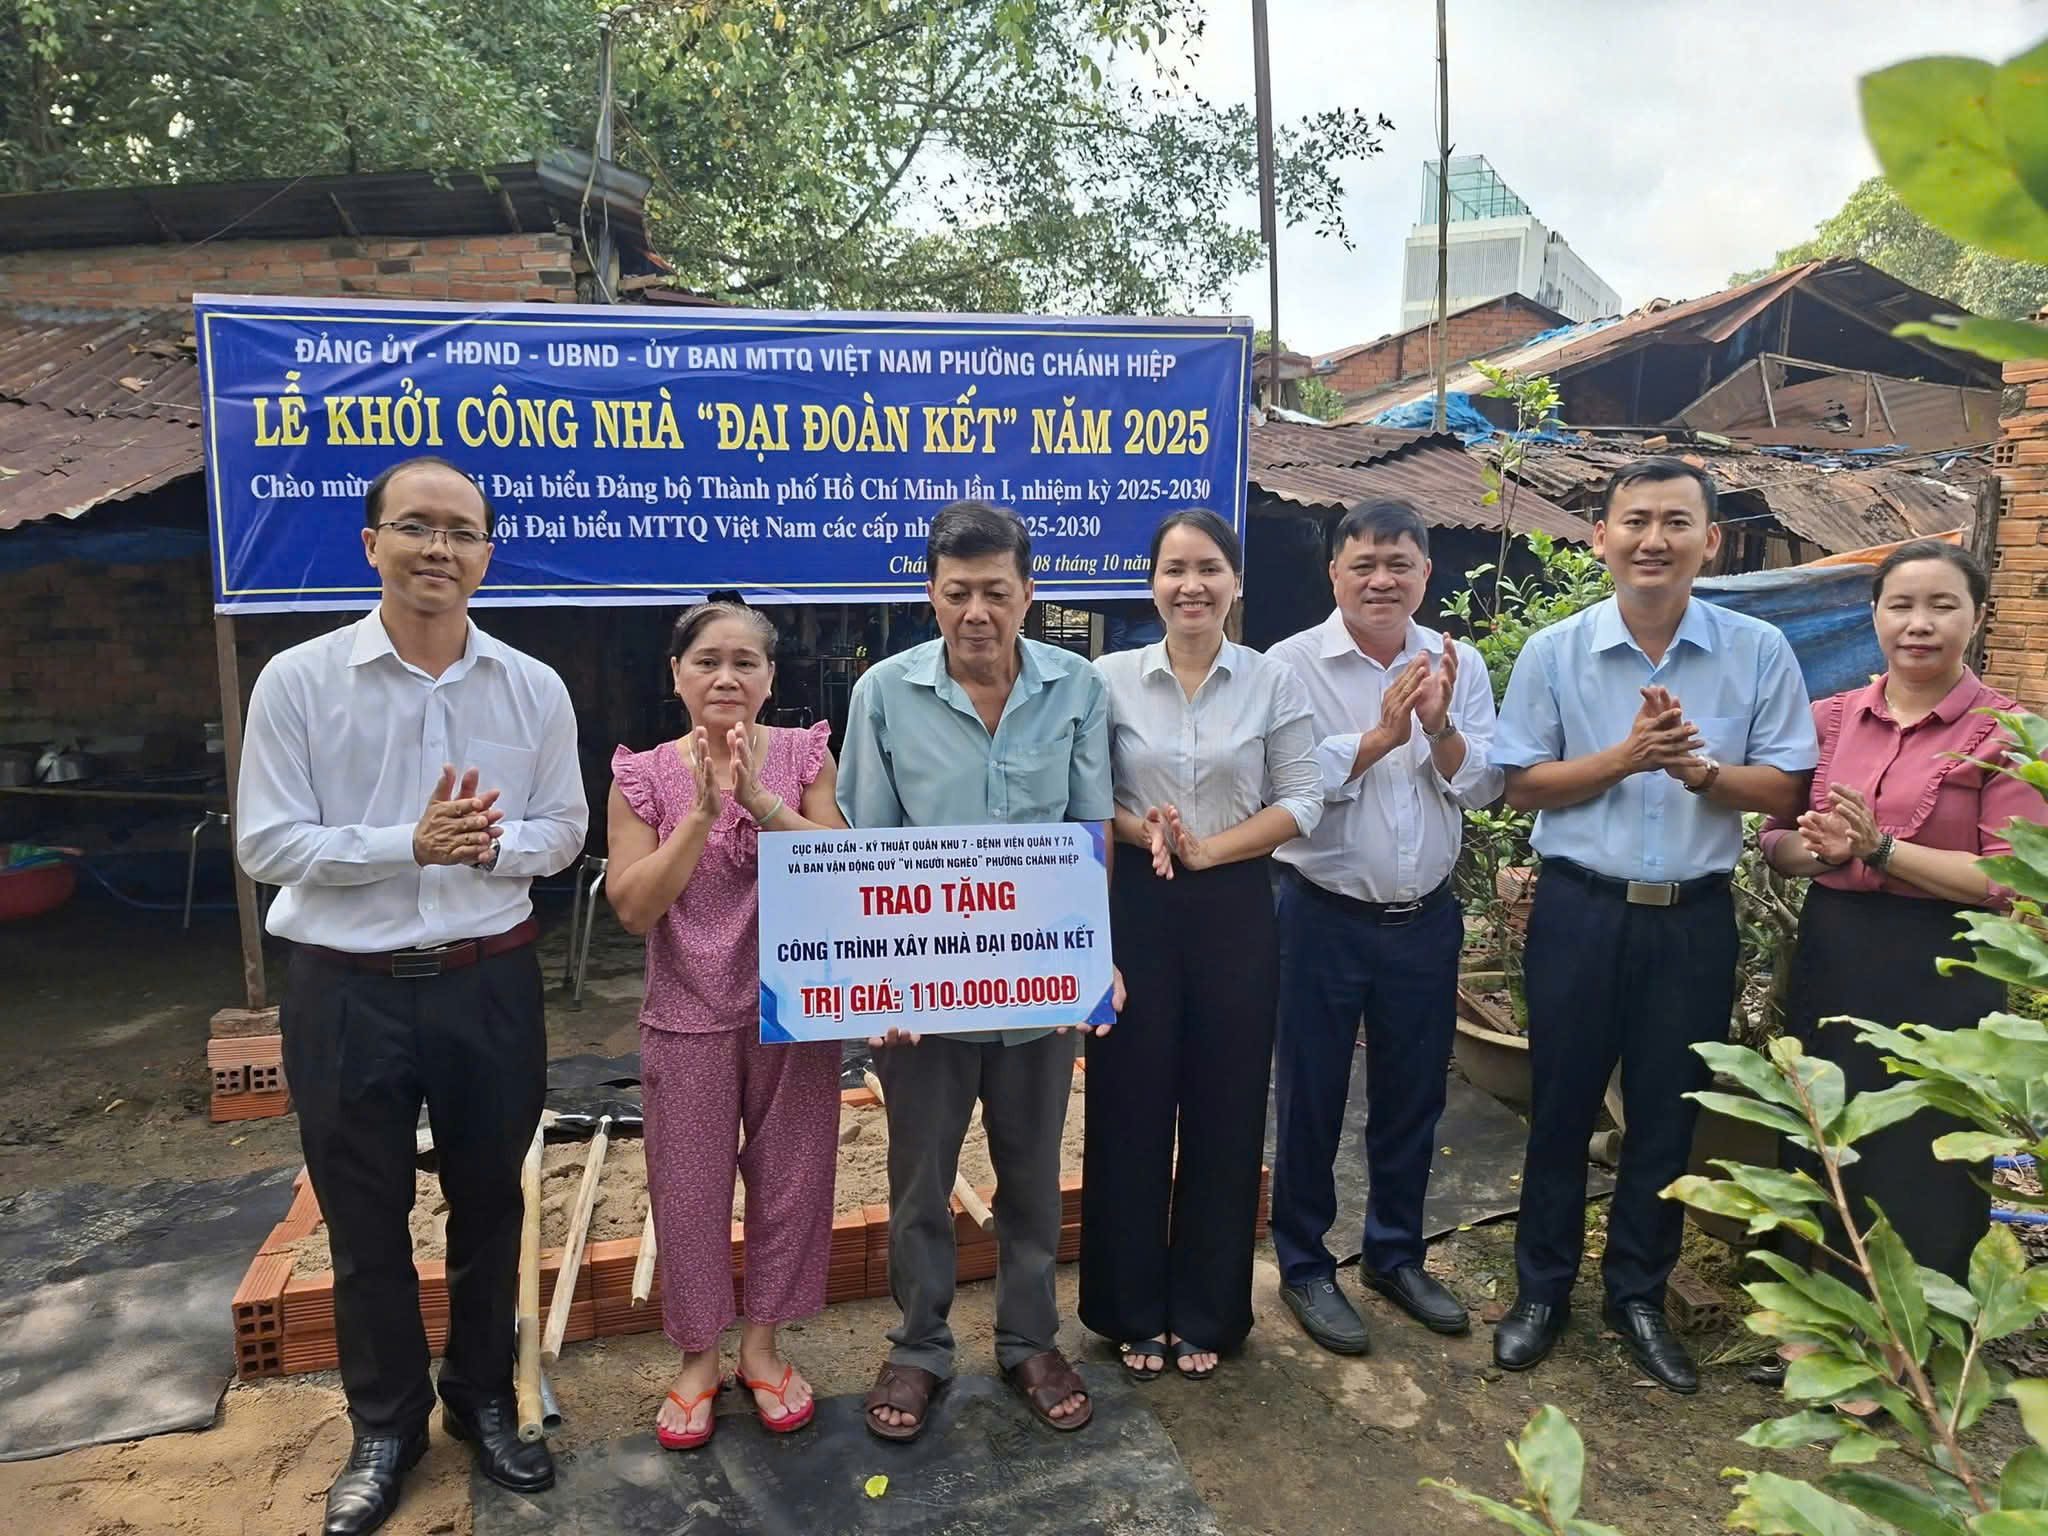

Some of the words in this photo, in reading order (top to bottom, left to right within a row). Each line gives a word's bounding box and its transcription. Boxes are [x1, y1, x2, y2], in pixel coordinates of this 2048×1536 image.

[295, 332, 372, 364] ĐẢNG
[382, 333, 417, 364] ỦY
[445, 341, 520, 365] HĐND
[548, 343, 619, 367] UBND
[646, 338, 679, 368] ỦY
[688, 347, 737, 369] BAN
[745, 347, 813, 373] MTTQ
[820, 343, 872, 377] VIỆT
[880, 349, 932, 374] NAM
[940, 347, 1036, 377] PHƯỜNG
[1043, 347, 1120, 378] CHÁNH
[1127, 349, 1177, 383] HIỆP
[253, 370, 309, 447] LỄ
[324, 378, 443, 447] KHỞI
[457, 384, 579, 448] CÔNG
[592, 386, 684, 450] NHÀ
[698, 402, 791, 464] “ĐẠI
[802, 391, 909, 454] ĐOÀN
[923, 385, 1018, 454] KẾT”
[1031, 395, 1112, 455] NĂM
[1124, 407, 1210, 455] 2025
[250, 473, 315, 500] Chào
[492, 474, 534, 504] Đại
[541, 469, 590, 499] biểu
[596, 470, 658, 504] Đảng
[664, 473, 692, 504] bộ
[697, 477, 769, 500] Thành
[777, 473, 818, 507] phố
[824, 473, 854, 501] Hồ
[860, 475, 898, 501] Chí
[903, 477, 959, 501] Minh
[964, 475, 995, 501] lần
[1021, 478, 1083, 506] nhiệm
[1087, 479, 1112, 506] kỳ
[1116, 479, 1211, 501] 2025-2030
[525, 514, 569, 543] Đại
[573, 509, 621, 539] biểu
[628, 516, 708, 543] MTTQ
[713, 515, 760, 543] Việt
[765, 516, 817, 539] Nam
[822, 515, 857, 539] các
[862, 511, 899, 543] cấp
[1033, 554, 1051, 571] 08
[1055, 554, 1098, 575] tháng
[1102, 554, 1120, 571] 10
[792, 844, 812, 856] CỤC
[814, 841, 834, 856] HẬU
[881, 839, 910, 853] THUẬT
[912, 838, 938, 851] QUÂN
[941, 839, 959, 850] KHU
[962, 839, 968, 849] 7
[976, 836, 1001, 850] BỆNH
[1004, 836, 1025, 849] VIỆN
[1027, 835, 1051, 848] QUÂN
[1054, 836, 1060, 846] Y
[1062, 836, 1074, 846] 7A
[803, 863, 824, 873] BAN
[826, 860, 846, 875] VẬN
[848, 859, 875, 874] ĐỘNG
[1025, 853, 1056, 866] CHÁNH
[1059, 853, 1079, 866] HIỆP
[859, 883, 931, 916] TRAO
[941, 876, 1016, 919] TẶNG
[777, 938, 828, 963] CÔNG
[833, 935, 888, 959] TRÌNH
[893, 934, 929, 957] XÂY
[934, 931, 971, 955] NHÀ
[976, 934, 1006, 959] ĐẠI
[1010, 928, 1059, 953] ĐOÀN
[1063, 925, 1095, 949] KẾT
[800, 985, 844, 1022] TRỊ
[850, 977, 903, 1015] GIÁ:
[909, 974, 1079, 1012] 110.000.000Đ
